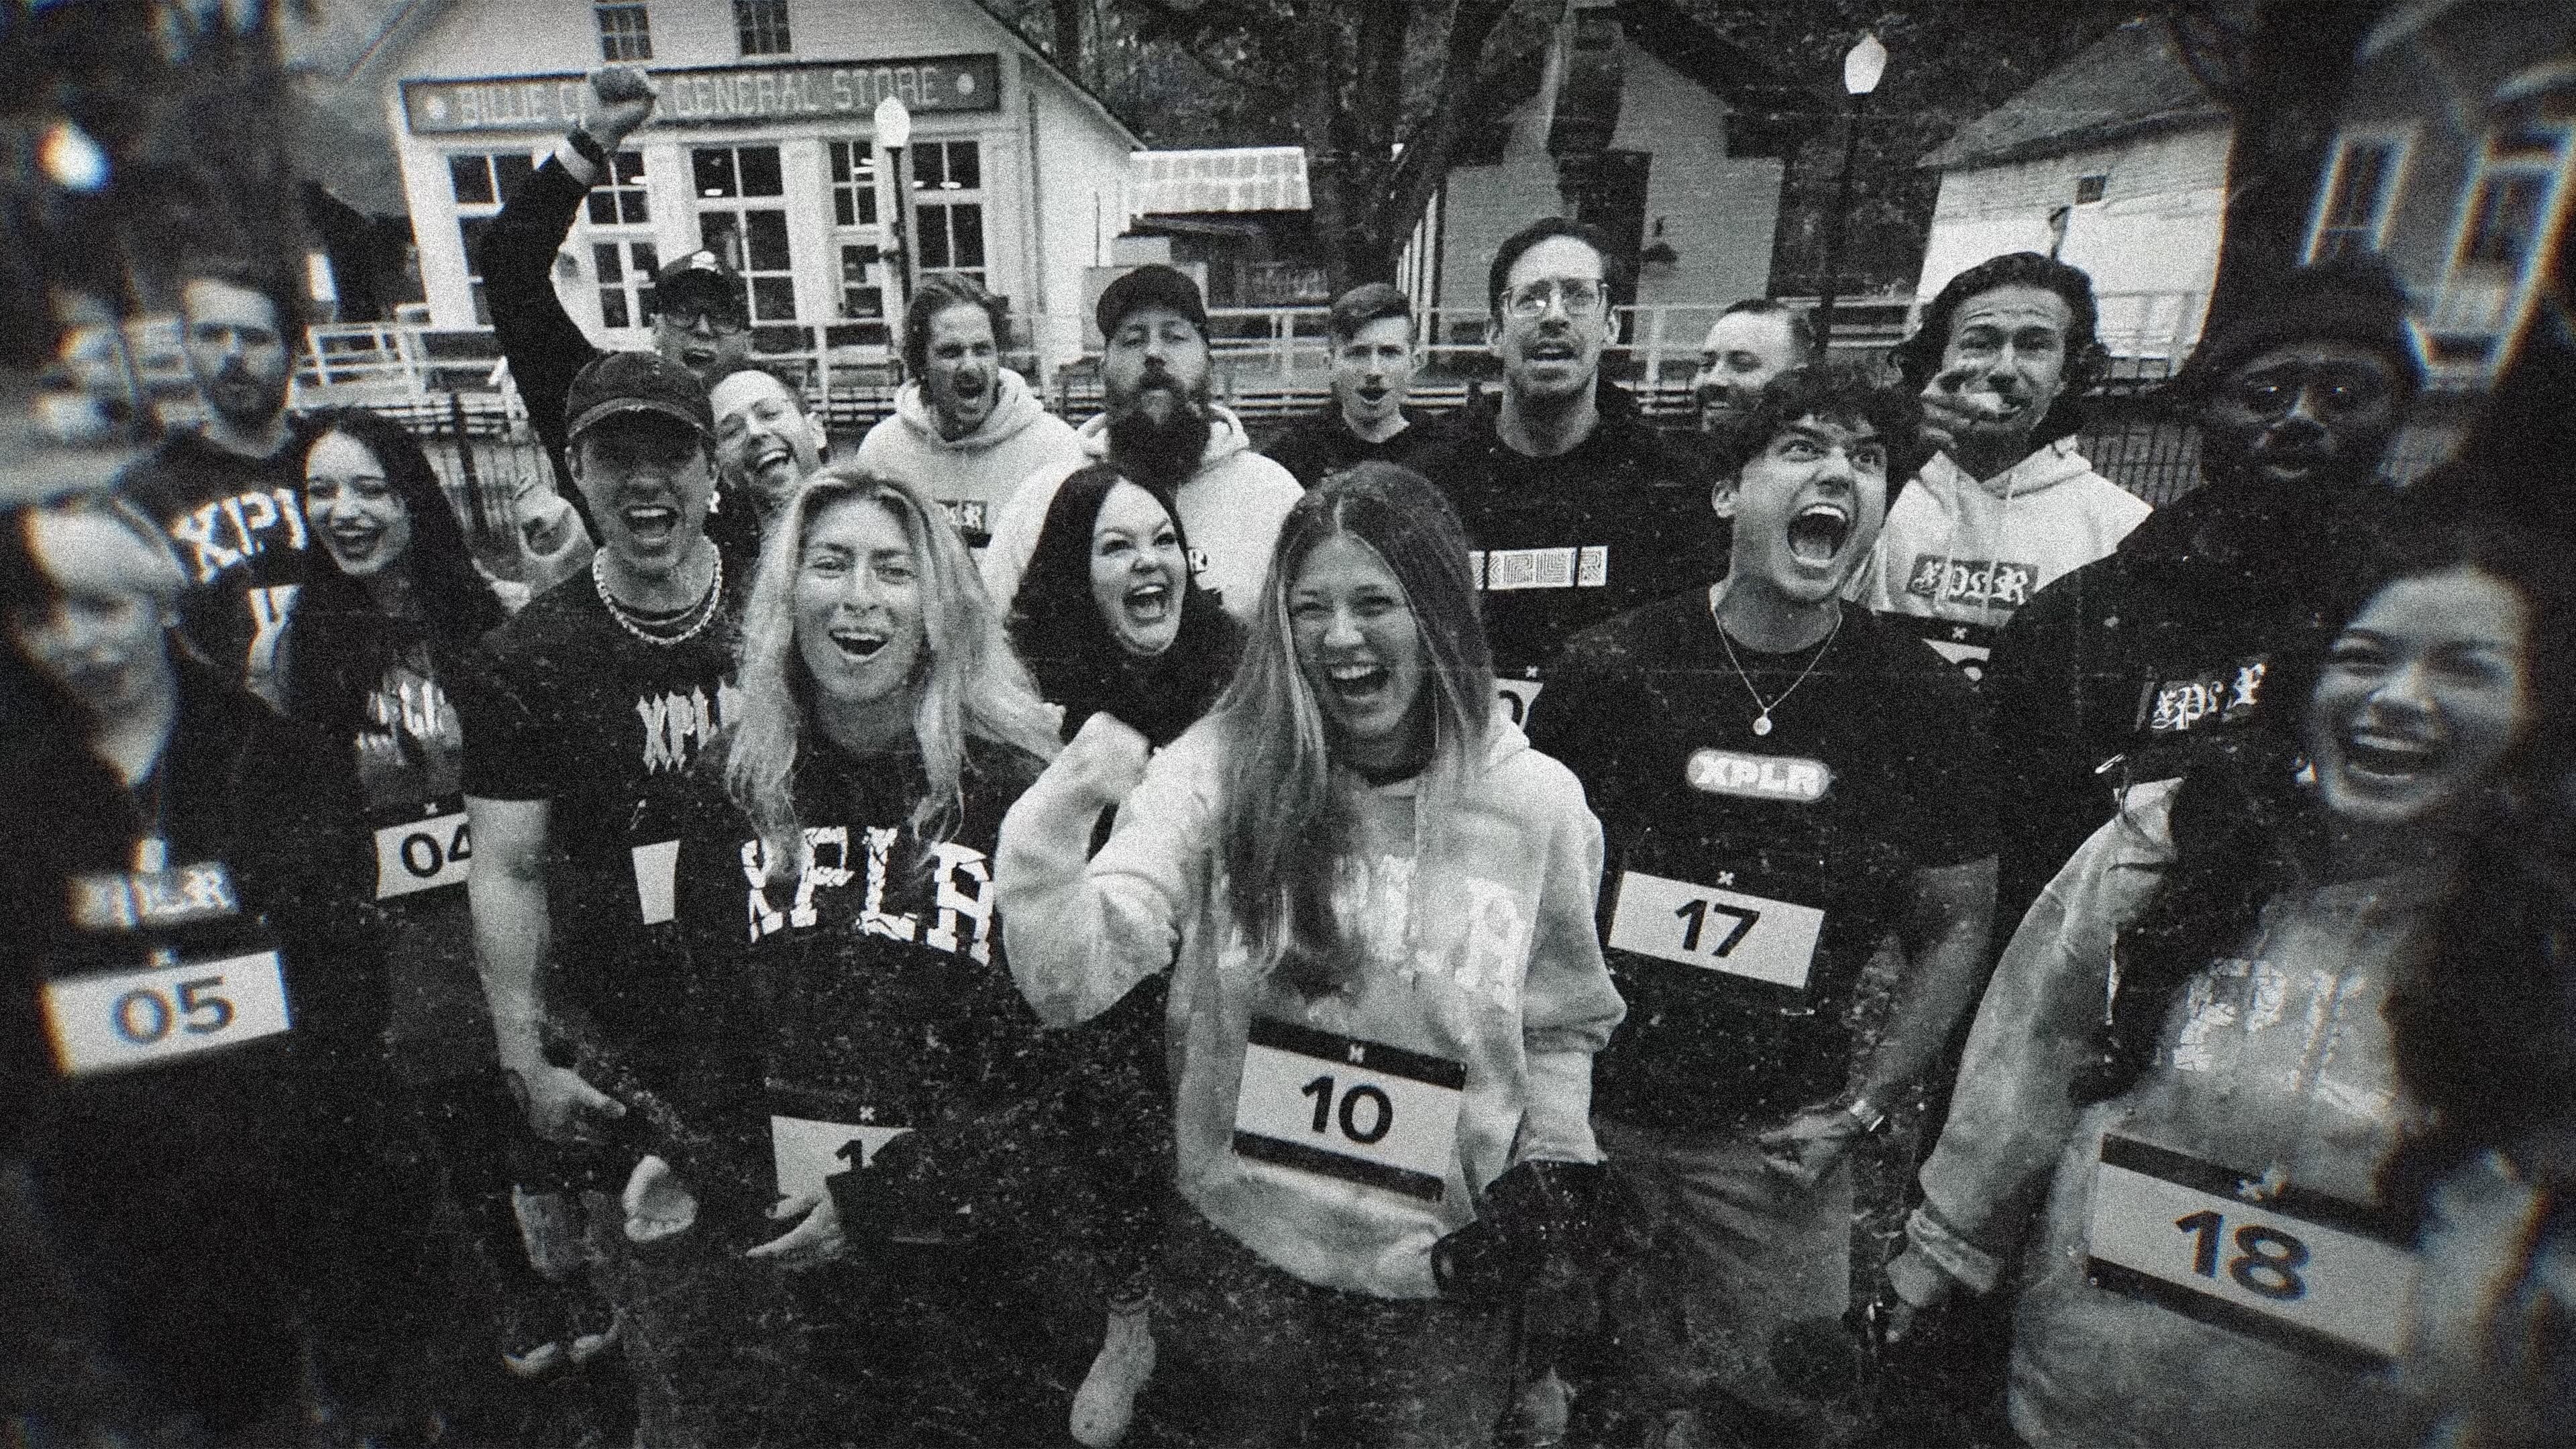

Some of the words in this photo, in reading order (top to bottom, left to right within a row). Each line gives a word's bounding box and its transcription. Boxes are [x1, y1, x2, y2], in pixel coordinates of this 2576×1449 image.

[456, 83, 547, 126] BILLIE
[672, 72, 820, 118] GENERAL
[832, 67, 940, 111] STORE
[1693, 753, 1822, 798] XPLR
[1674, 898, 1762, 959] 17
[111, 973, 236, 1044] 05
[1300, 1075, 1394, 1146] 10
[2174, 1208, 2314, 1303] 18
